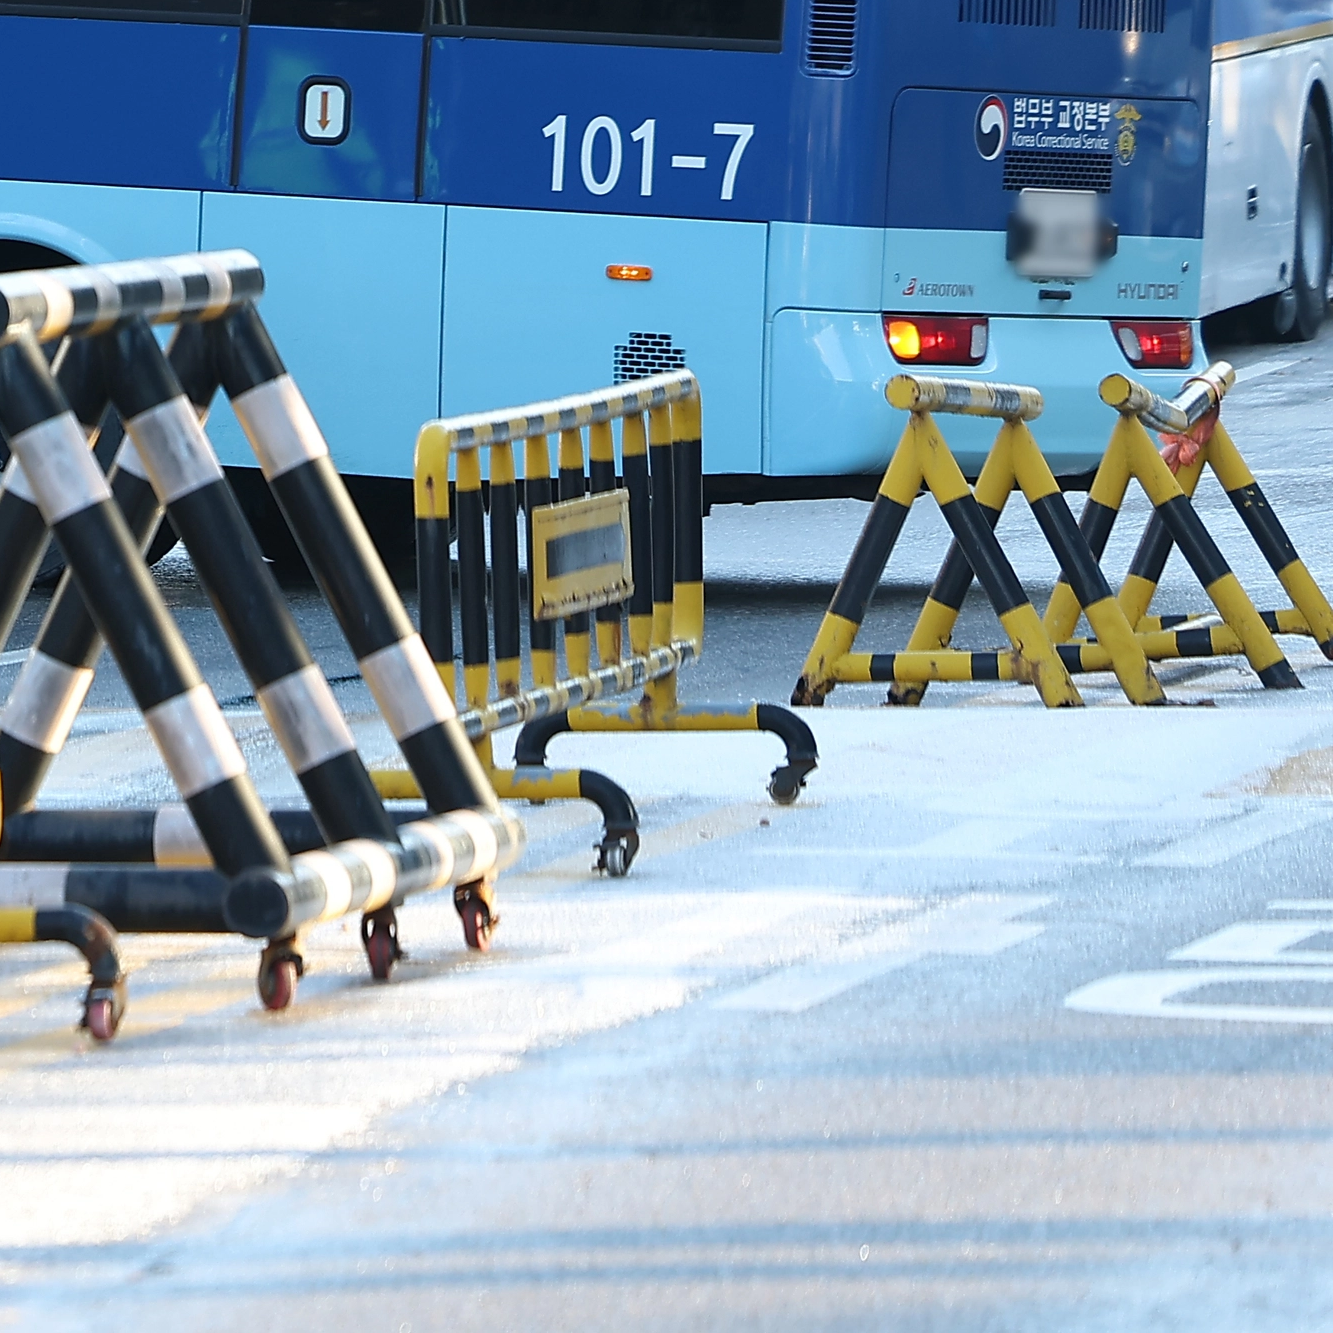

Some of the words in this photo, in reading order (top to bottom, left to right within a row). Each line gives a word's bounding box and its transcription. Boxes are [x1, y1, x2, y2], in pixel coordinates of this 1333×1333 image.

[1013, 97, 1053, 129] 법무부
[1057, 100, 1111, 131] 교정본부
[1012, 131, 1034, 147] Korea
[1036, 132, 1082, 149] Correctional
[1082, 133, 1109, 149] Service
[541, 114, 755, 201] 101-7
[917, 283, 974, 298] AEROTOWN
[1117, 282, 1179, 300] HYUNDAI
